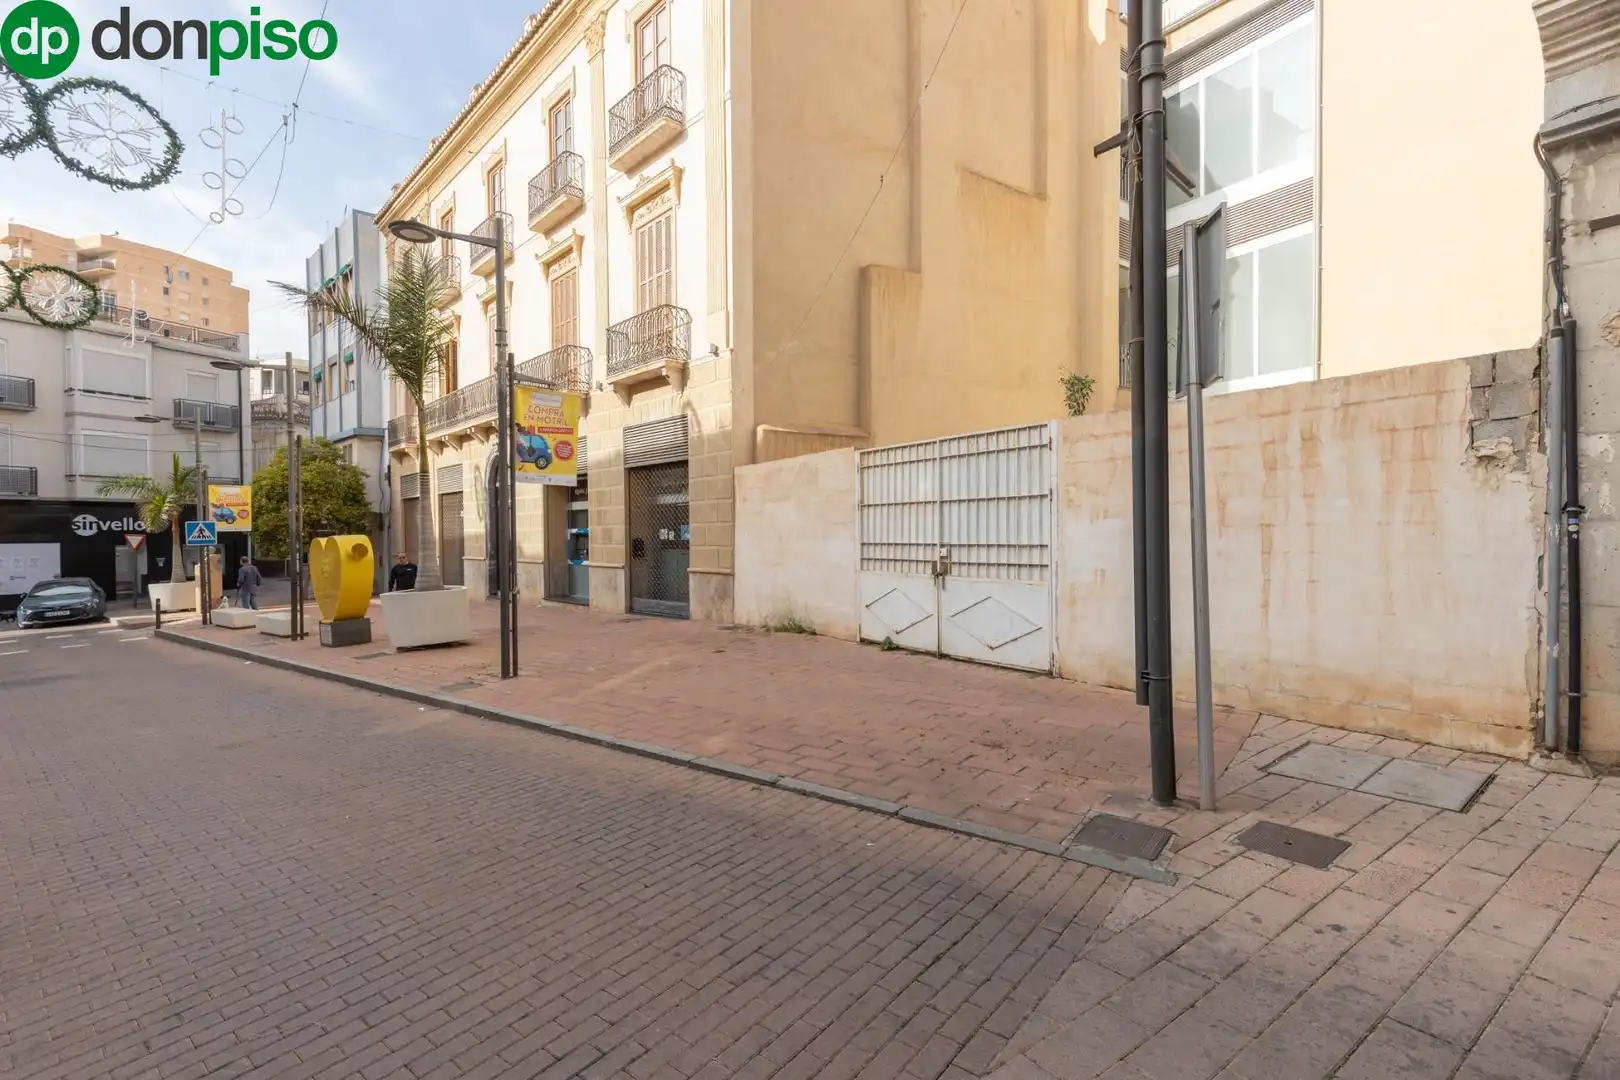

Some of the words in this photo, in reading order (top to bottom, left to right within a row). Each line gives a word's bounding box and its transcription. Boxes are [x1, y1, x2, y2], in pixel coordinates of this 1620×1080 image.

[523, 413, 535, 421] EN
[528, 405, 564, 417] COMPRA
[72, 516, 146, 531] sinvello
